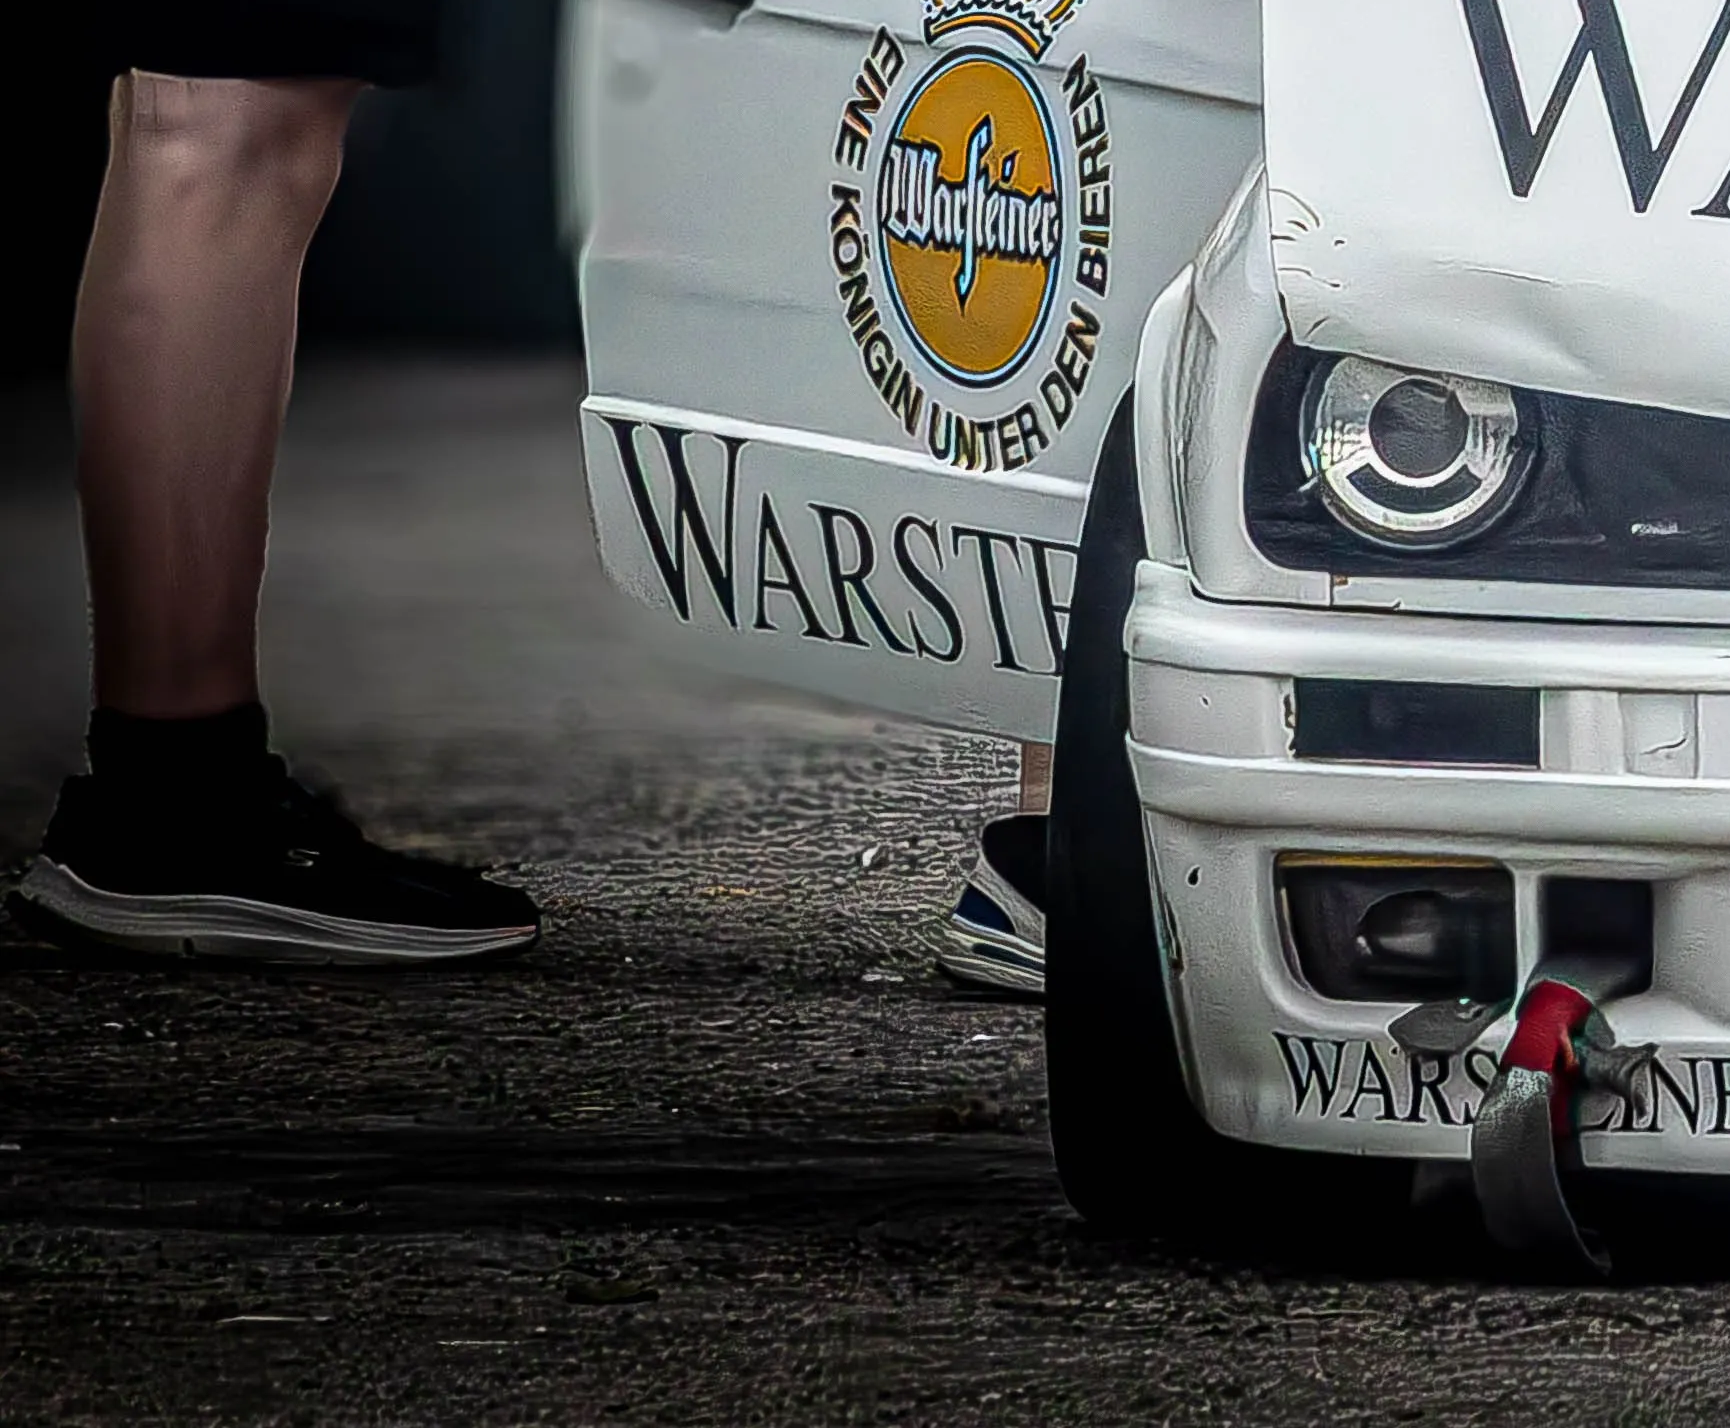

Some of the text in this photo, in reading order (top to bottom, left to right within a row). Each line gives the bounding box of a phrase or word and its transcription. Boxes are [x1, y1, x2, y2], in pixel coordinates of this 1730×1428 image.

[831, 27, 1112, 473] EINE KÖNIGIN UNTER DEN BIEREN
